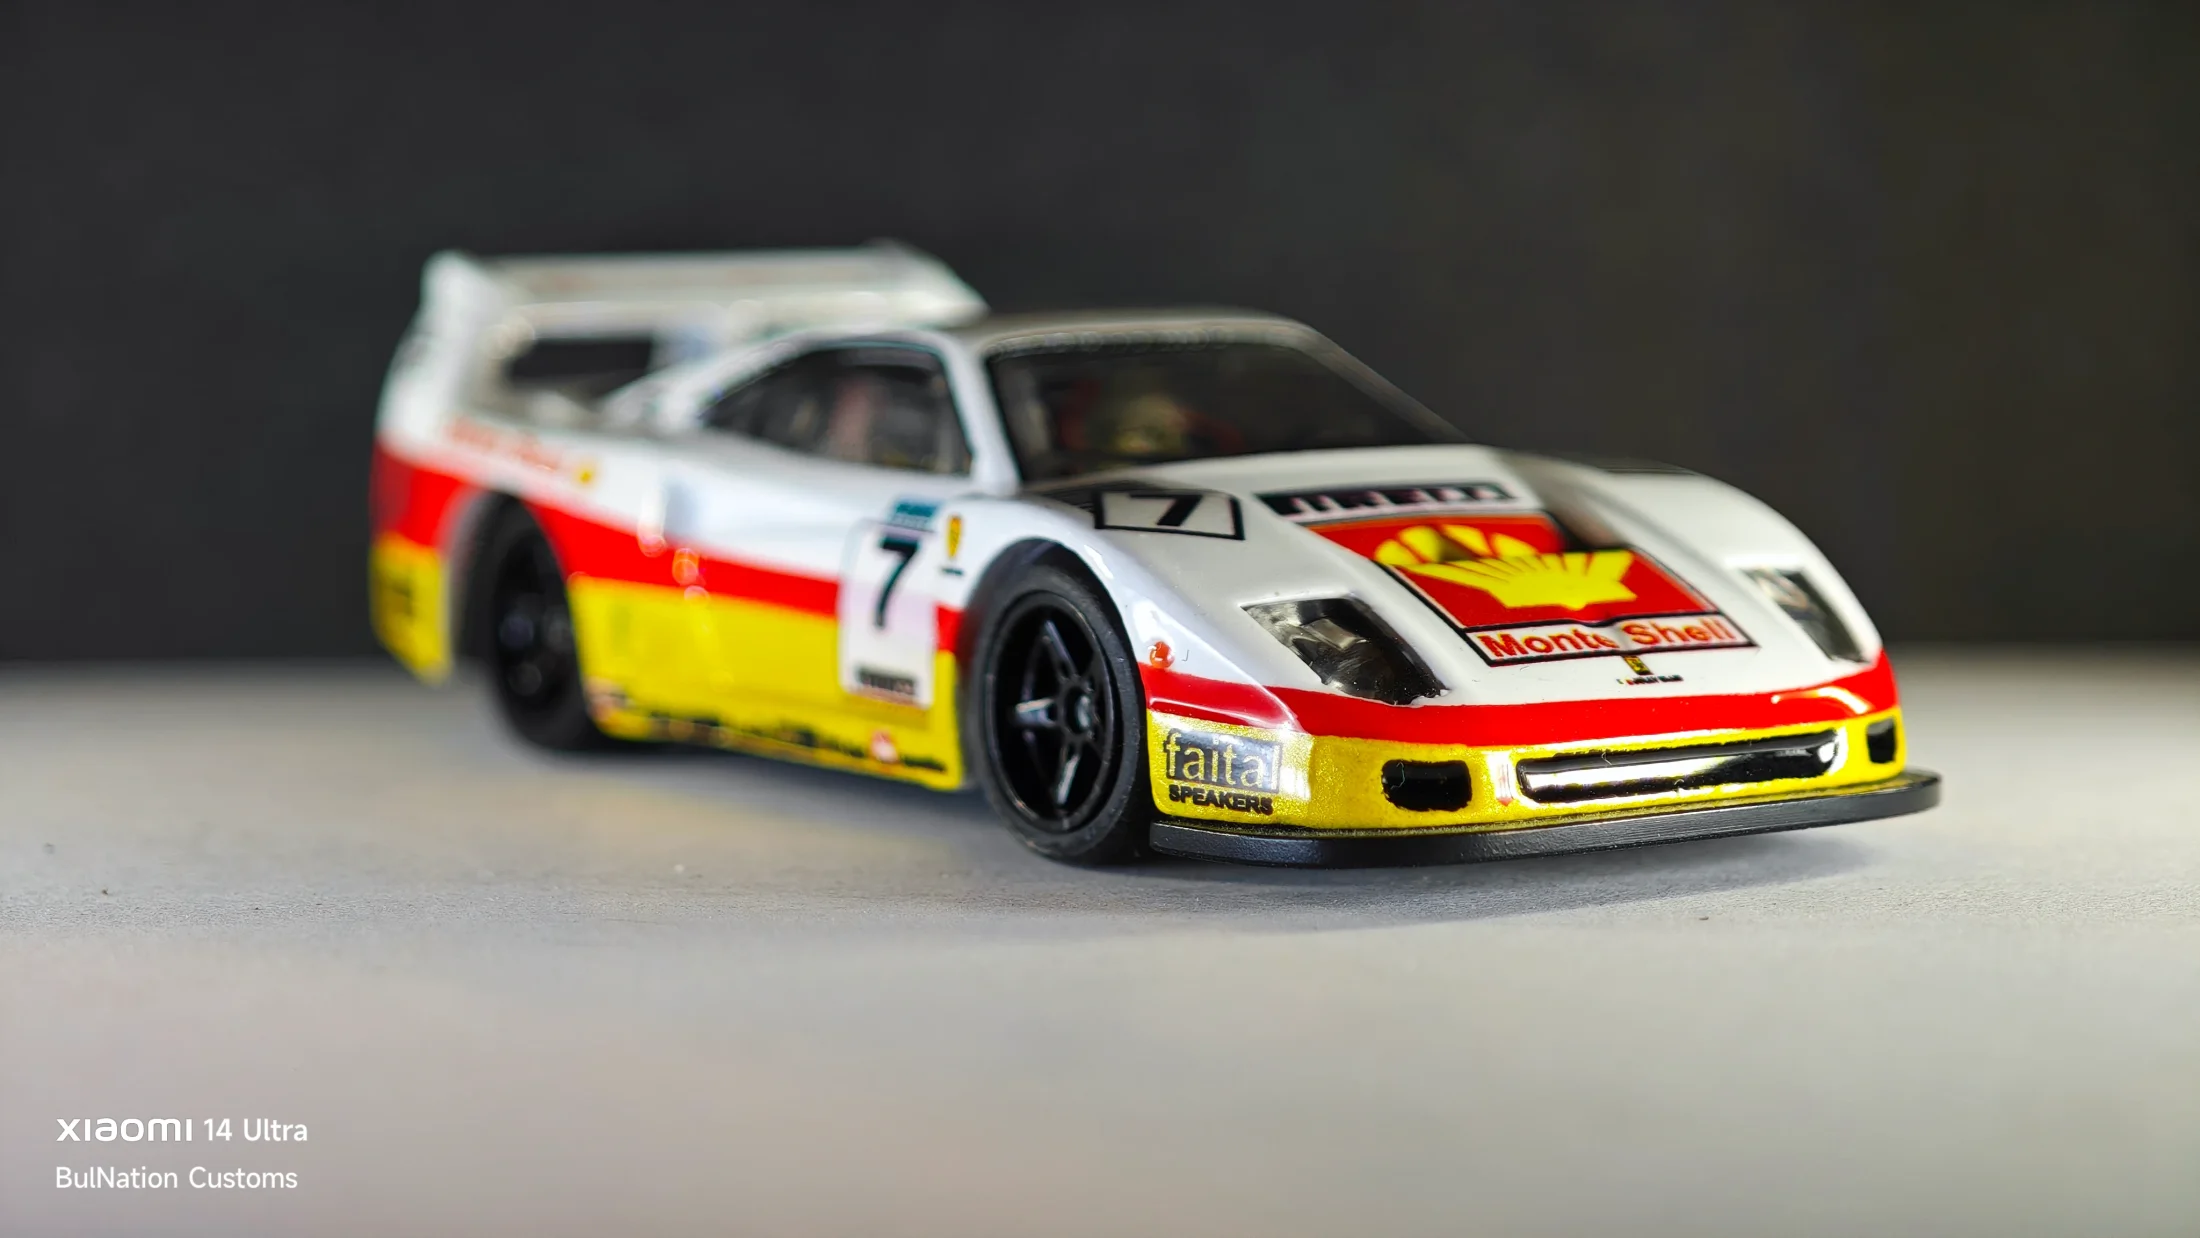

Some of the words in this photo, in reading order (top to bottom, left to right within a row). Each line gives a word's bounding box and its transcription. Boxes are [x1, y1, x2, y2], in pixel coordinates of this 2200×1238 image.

[1129, 493, 1203, 527] 7
[876, 534, 920, 629] 7
[1477, 629, 1620, 658] Monte
[1622, 619, 1735, 646] Shell
[1165, 730, 1281, 790] faital
[1168, 784, 1274, 816] SPEAKERS
